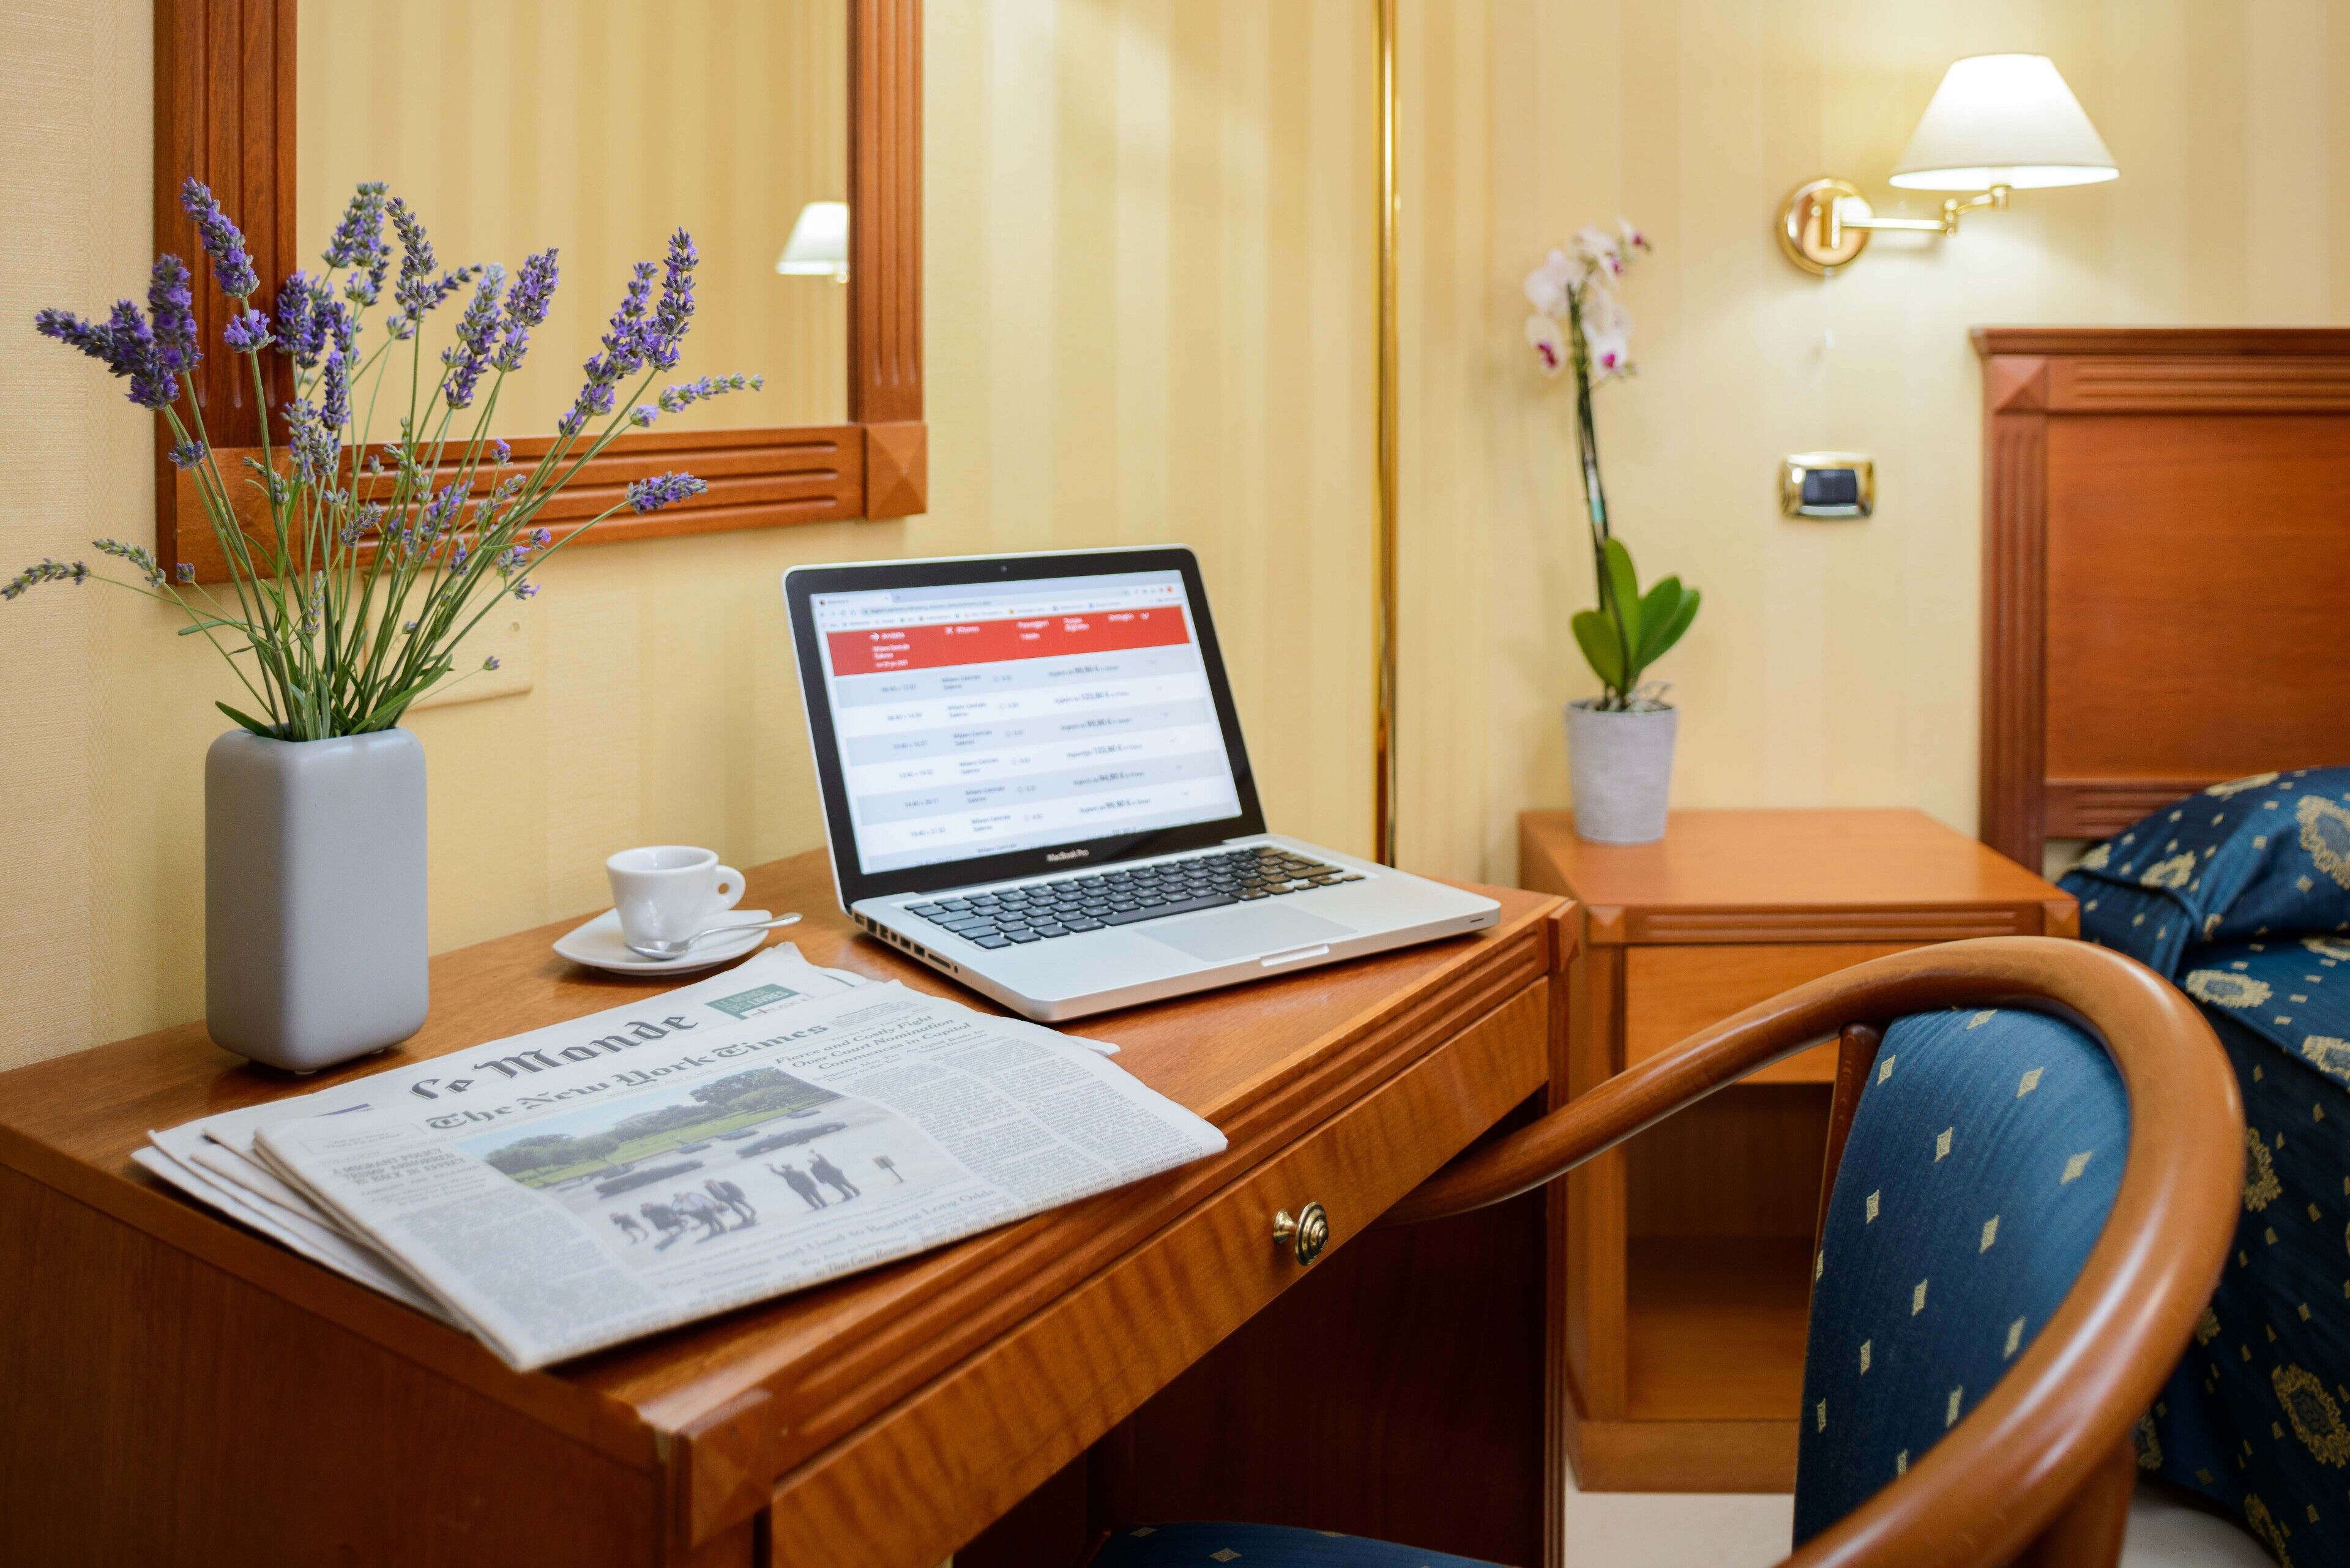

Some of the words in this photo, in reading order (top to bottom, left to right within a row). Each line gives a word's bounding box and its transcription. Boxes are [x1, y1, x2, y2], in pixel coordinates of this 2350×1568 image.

[1046, 851, 1075, 862] MacBook
[1076, 848, 1089, 858] Pro
[726, 1002, 748, 1012] DES
[748, 990, 789, 1006] LIVRES
[409, 1078, 476, 1100] Le
[473, 1014, 698, 1078] Monde
[775, 1050, 821, 1064] Fierce
[824, 1040, 851, 1051] and
[853, 1028, 894, 1041] Costly
[897, 1016, 933, 1029] Fight
[793, 1056, 827, 1067] Over
[831, 1043, 871, 1056] Court
[873, 1020, 954, 1045] Nomination
[819, 1044, 904, 1069] Commences
[922, 1023, 971, 1039] Capitol
[425, 1106, 512, 1130] The
[517, 1081, 612, 1109] New
[610, 1055, 715, 1086] York
[717, 1024, 829, 1058] Times
